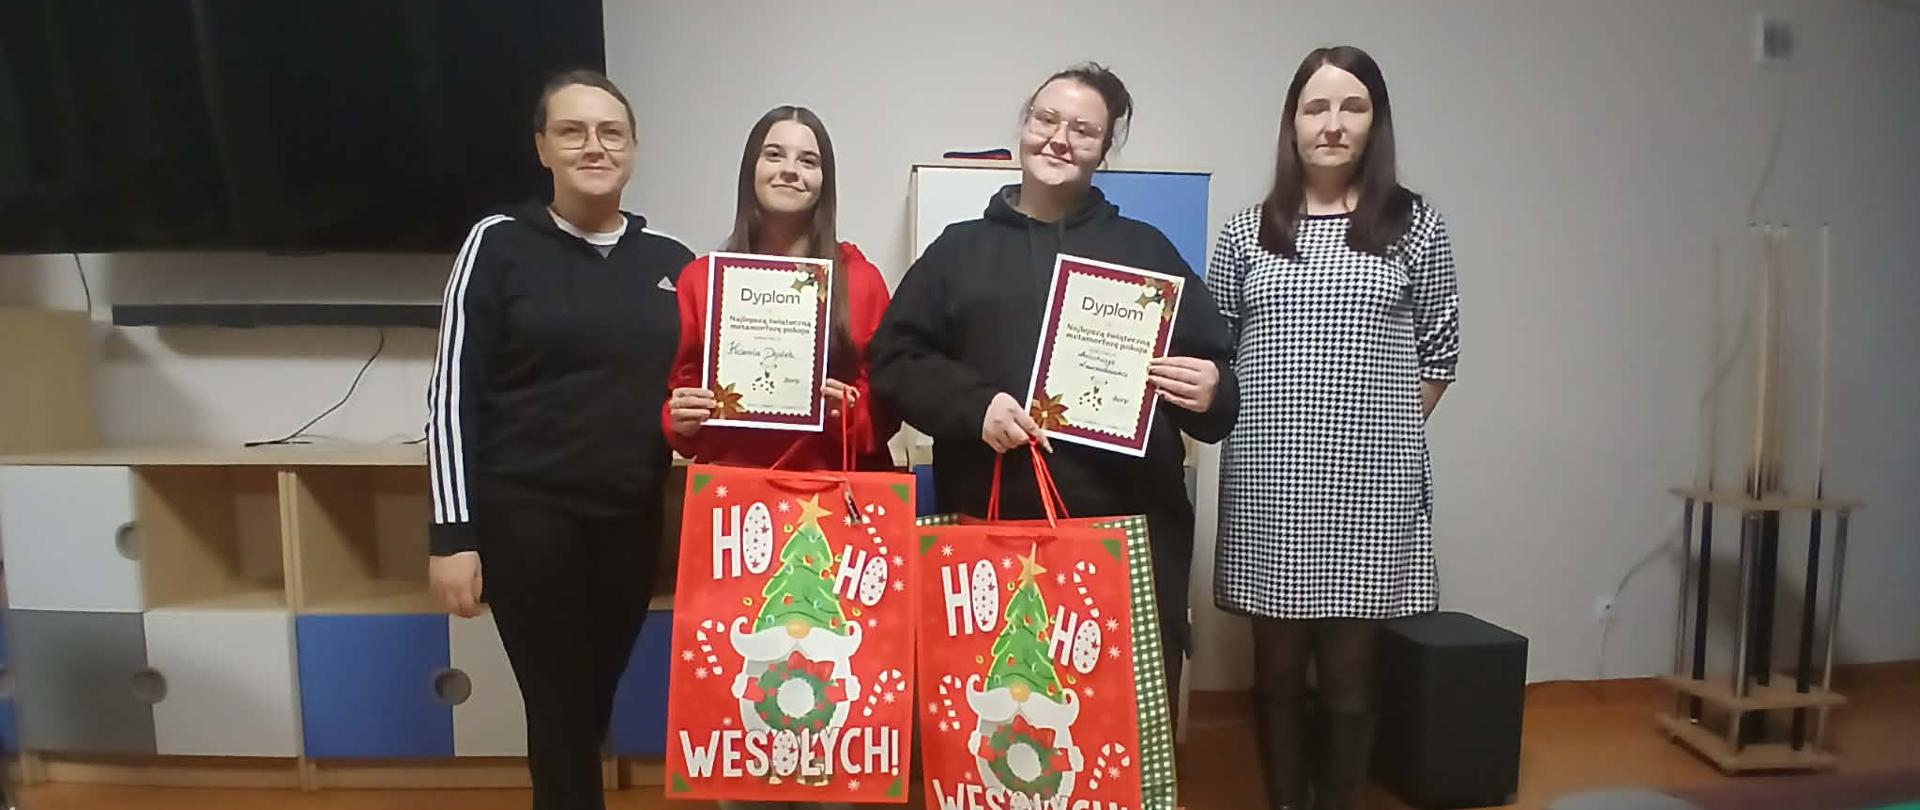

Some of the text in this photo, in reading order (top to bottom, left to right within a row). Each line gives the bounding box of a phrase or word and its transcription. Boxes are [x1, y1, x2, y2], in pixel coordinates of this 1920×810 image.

[741, 288, 801, 306] Dyplom
[1082, 296, 1143, 322] Dyplom
[712, 502, 773, 580] HO
[832, 544, 888, 607] HO
[941, 559, 999, 637] HO
[1047, 605, 1102, 674] HO
[679, 726, 899, 778] WESOŁYCH!
